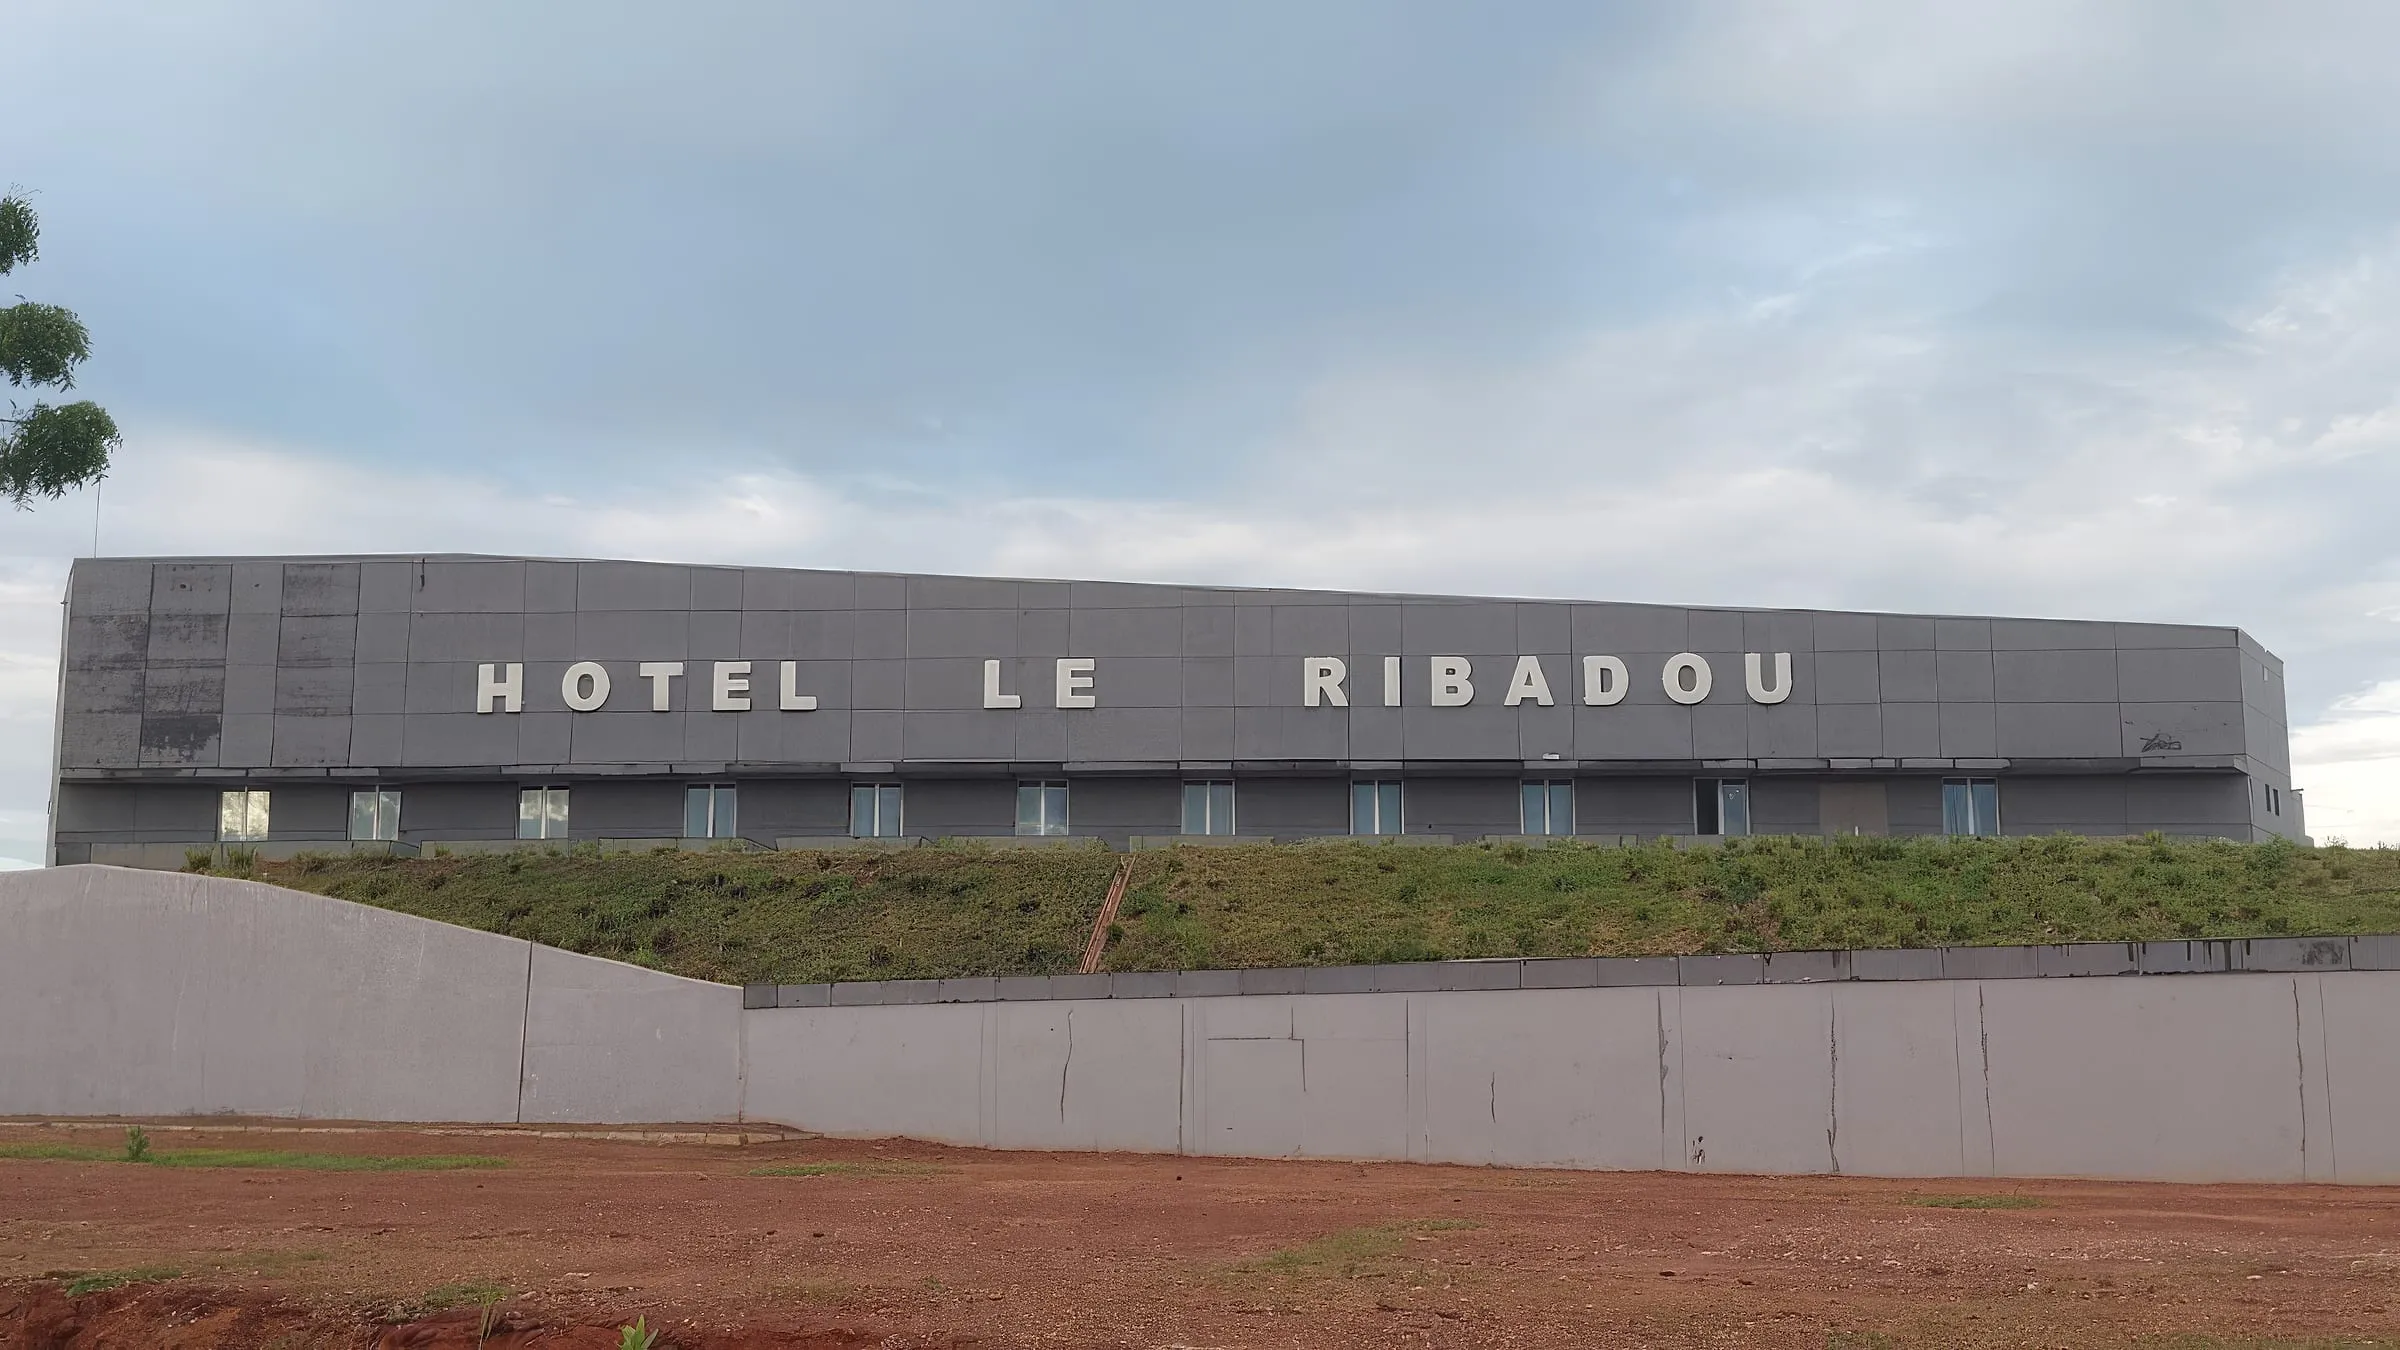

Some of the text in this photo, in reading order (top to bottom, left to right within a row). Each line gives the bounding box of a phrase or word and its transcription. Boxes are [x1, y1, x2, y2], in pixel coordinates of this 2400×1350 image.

[475, 652, 1794, 714] HOTEL LE RIBADOU
